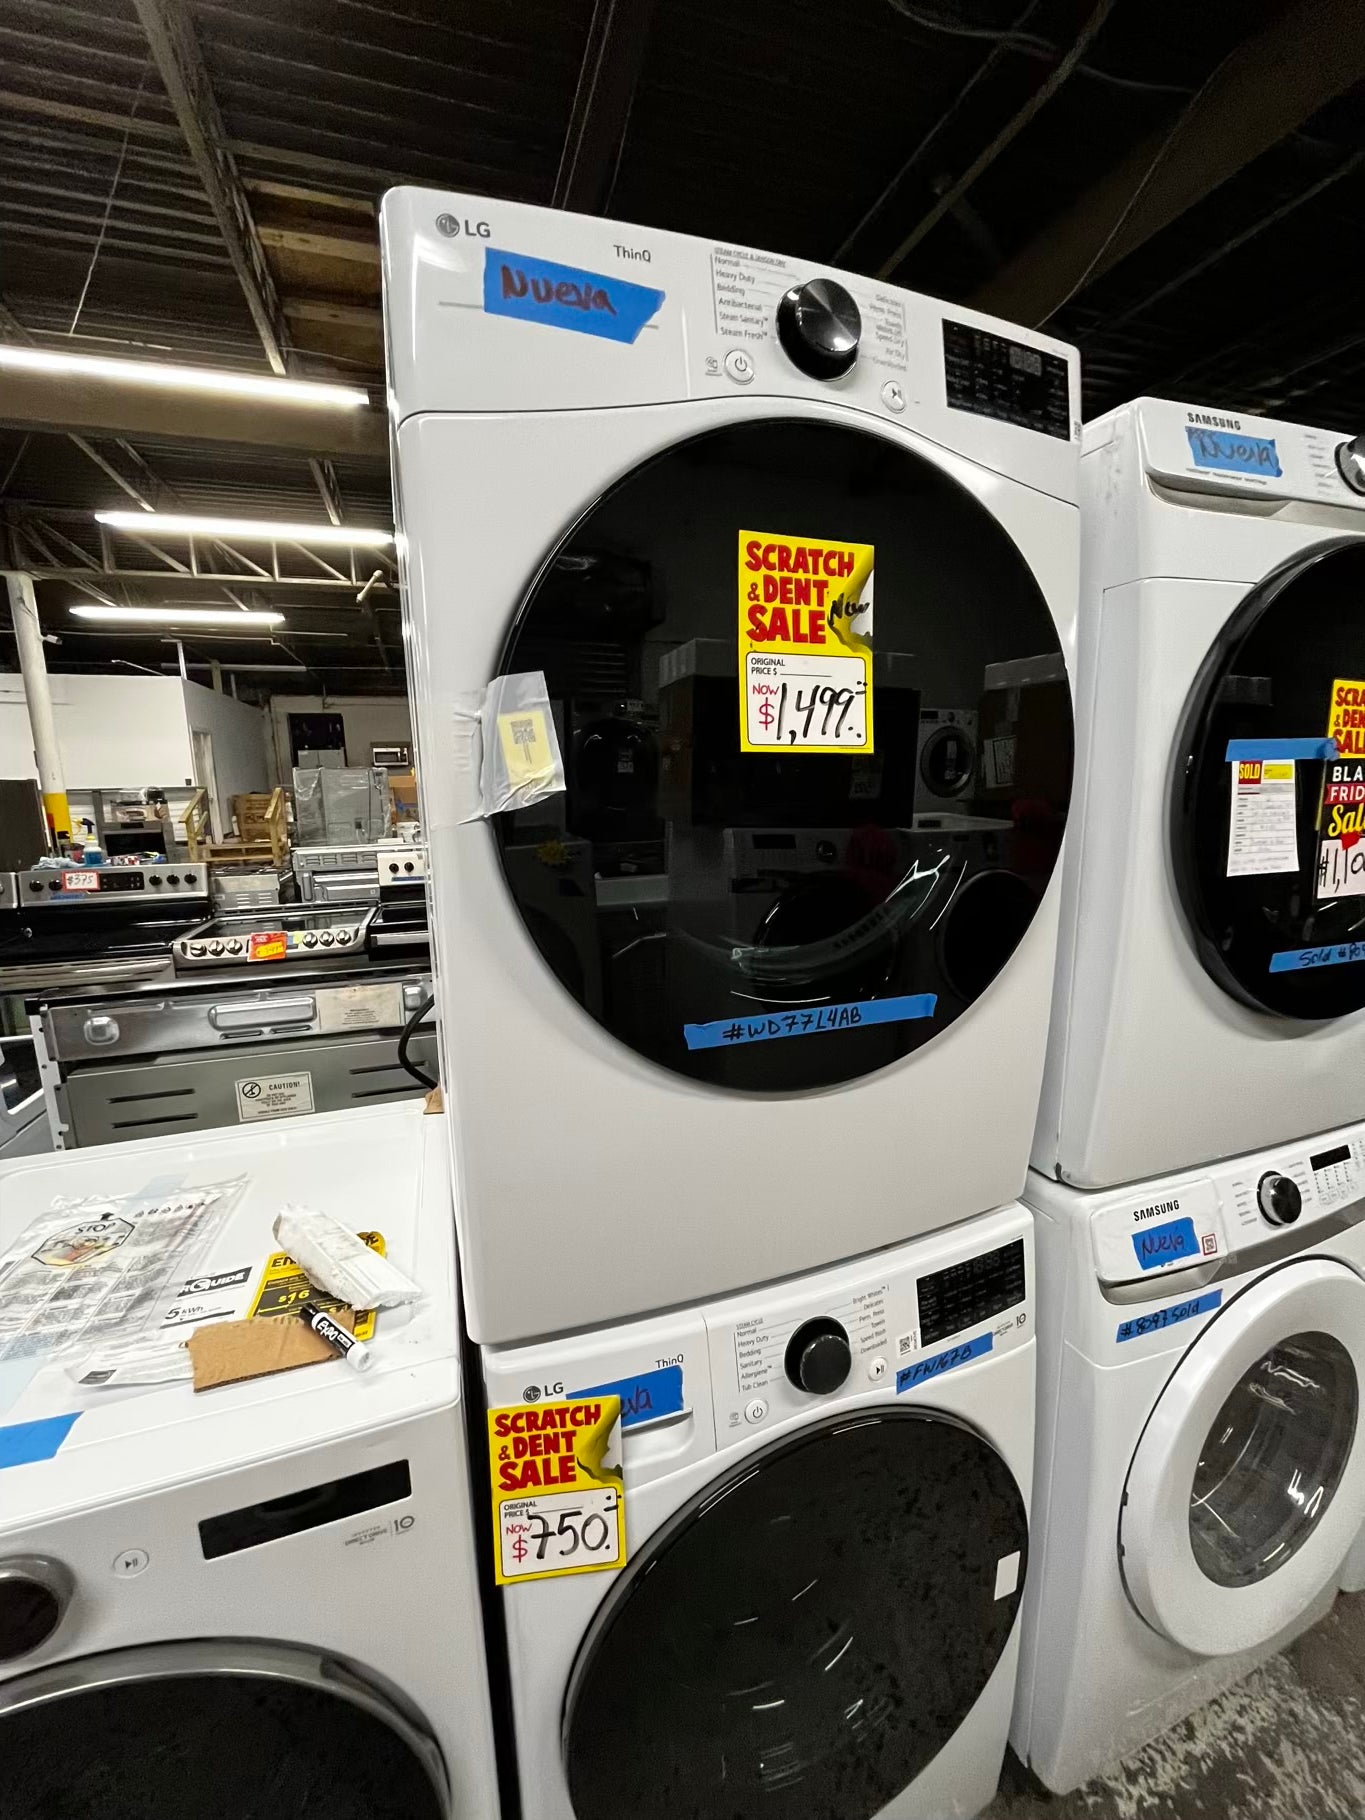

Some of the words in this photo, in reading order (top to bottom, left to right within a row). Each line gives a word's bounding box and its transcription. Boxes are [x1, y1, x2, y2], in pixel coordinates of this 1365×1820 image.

[465, 219, 490, 238] LG
[613, 244, 651, 264] ThinQ
[1187, 412, 1241, 431] SAMSUNG
[745, 540, 855, 577] SCRATCH
[748, 582, 760, 602] &
[763, 574, 829, 607] DENT
[746, 604, 827, 645] SALE
[751, 657, 785, 667] ORIGINAL
[751, 667, 771, 675] PRICE
[773, 667, 778, 676] $
[752, 683, 779, 695] NOW
[1333, 729, 1365, 755] SAL
[1239, 763, 1261, 779] SOLD
[1328, 802, 1365, 837] Sal
[1133, 1199, 1180, 1222] SAMSUNG
[76, 1222, 116, 1235] STOP
[316, 1320, 338, 1341] EXPO
[737, 1327, 757, 1337] Normal
[655, 1353, 684, 1369] ThinQ
[544, 1382, 564, 1397] LG
[495, 1404, 602, 1437] SCRATCH
[498, 1445, 511, 1460] &
[512, 1430, 577, 1460] DENT
[498, 1454, 577, 1492] SALE
[503, 1500, 538, 1510] ORIGINAL
[503, 1510, 524, 1519] PRICE
[505, 1522, 532, 1536] NOW
